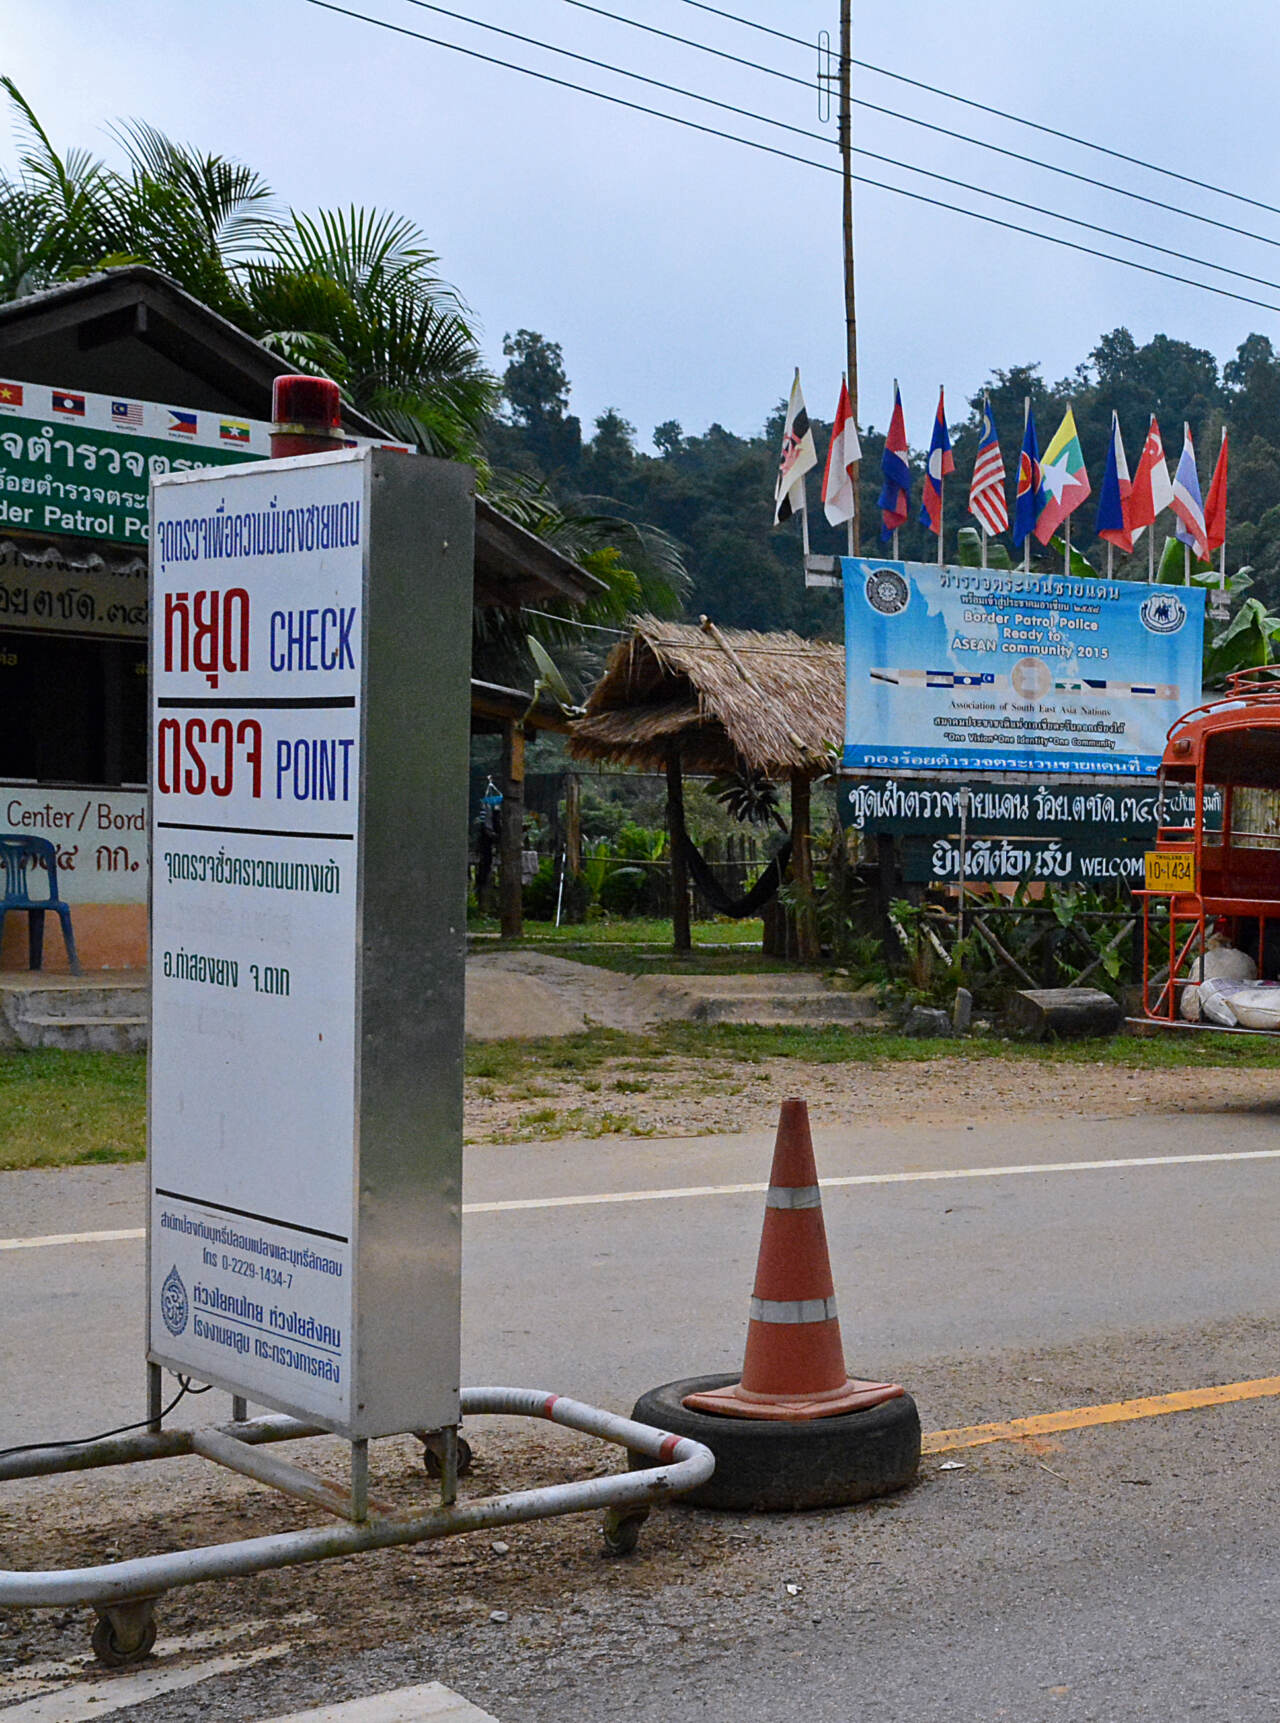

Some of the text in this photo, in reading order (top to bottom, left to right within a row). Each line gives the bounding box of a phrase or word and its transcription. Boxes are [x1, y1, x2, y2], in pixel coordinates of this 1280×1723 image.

[44, 505, 114, 535] Patrol
[157, 494, 361, 574] จุดตรวจเพื่อความมั่นคงชายแดน
[940, 571, 1121, 600] ตำรวจตระเวนชายแดน
[164, 587, 250, 689] หยุด
[964, 611, 1099, 632] Border Patrol Police
[1003, 628, 1061, 643] Ready to
[270, 607, 357, 673] CHECK
[952, 638, 1109, 660] ASEAN community 2015
[951, 700, 1112, 717] Association of South East Asia Nations
[158, 718, 262, 799] ตรวจ
[1071, 737, 1117, 751] Community
[276, 738, 355, 802] POINT
[7, 800, 75, 829] Center
[97, 803, 145, 831] Bord
[164, 846, 340, 894] จุดตรวจชั่วคราวถนนทางเข้า
[932, 839, 1072, 876] ยินดีต้อนรับ
[1080, 857, 1146, 877] WELCOM
[1149, 861, 1191, 880] 10-1434
[164, 948, 290, 997] อ.ท่าสองยาง จ.ตาก
[203, 1247, 293, 1289] โทร 0-2229-1434-7
[193, 1313, 251, 1356] โรงงานยาสูบ
